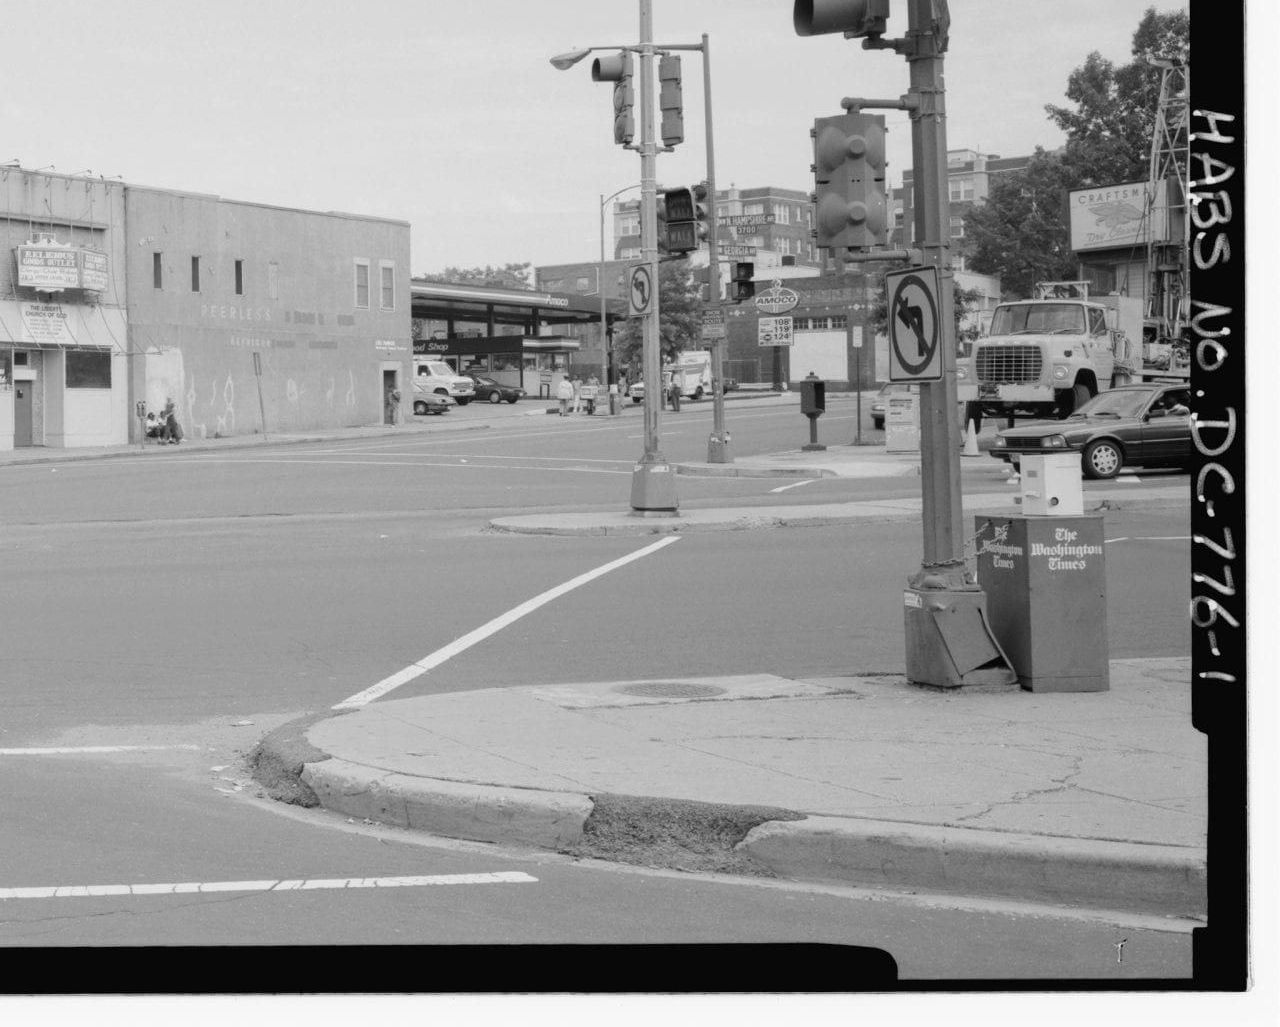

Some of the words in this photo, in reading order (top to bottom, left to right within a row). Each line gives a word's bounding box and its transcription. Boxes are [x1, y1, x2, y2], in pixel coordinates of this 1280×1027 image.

[732, 215, 767, 226] HAMPSHIRE
[24, 251, 75, 260] RELIGIOUS
[723, 246, 748, 256] GEORGIA
[47, 258, 75, 267] OUTLET
[545, 294, 569, 307] Amoco
[756, 297, 797, 305] AMOCO
[201, 304, 271, 321] PEERLESS
[427, 342, 449, 355] Shop
[1054, 527, 1078, 545] The
[1029, 542, 1103, 559] Washington
[992, 555, 1015, 570] Times
[1047, 557, 1087, 571] Times
